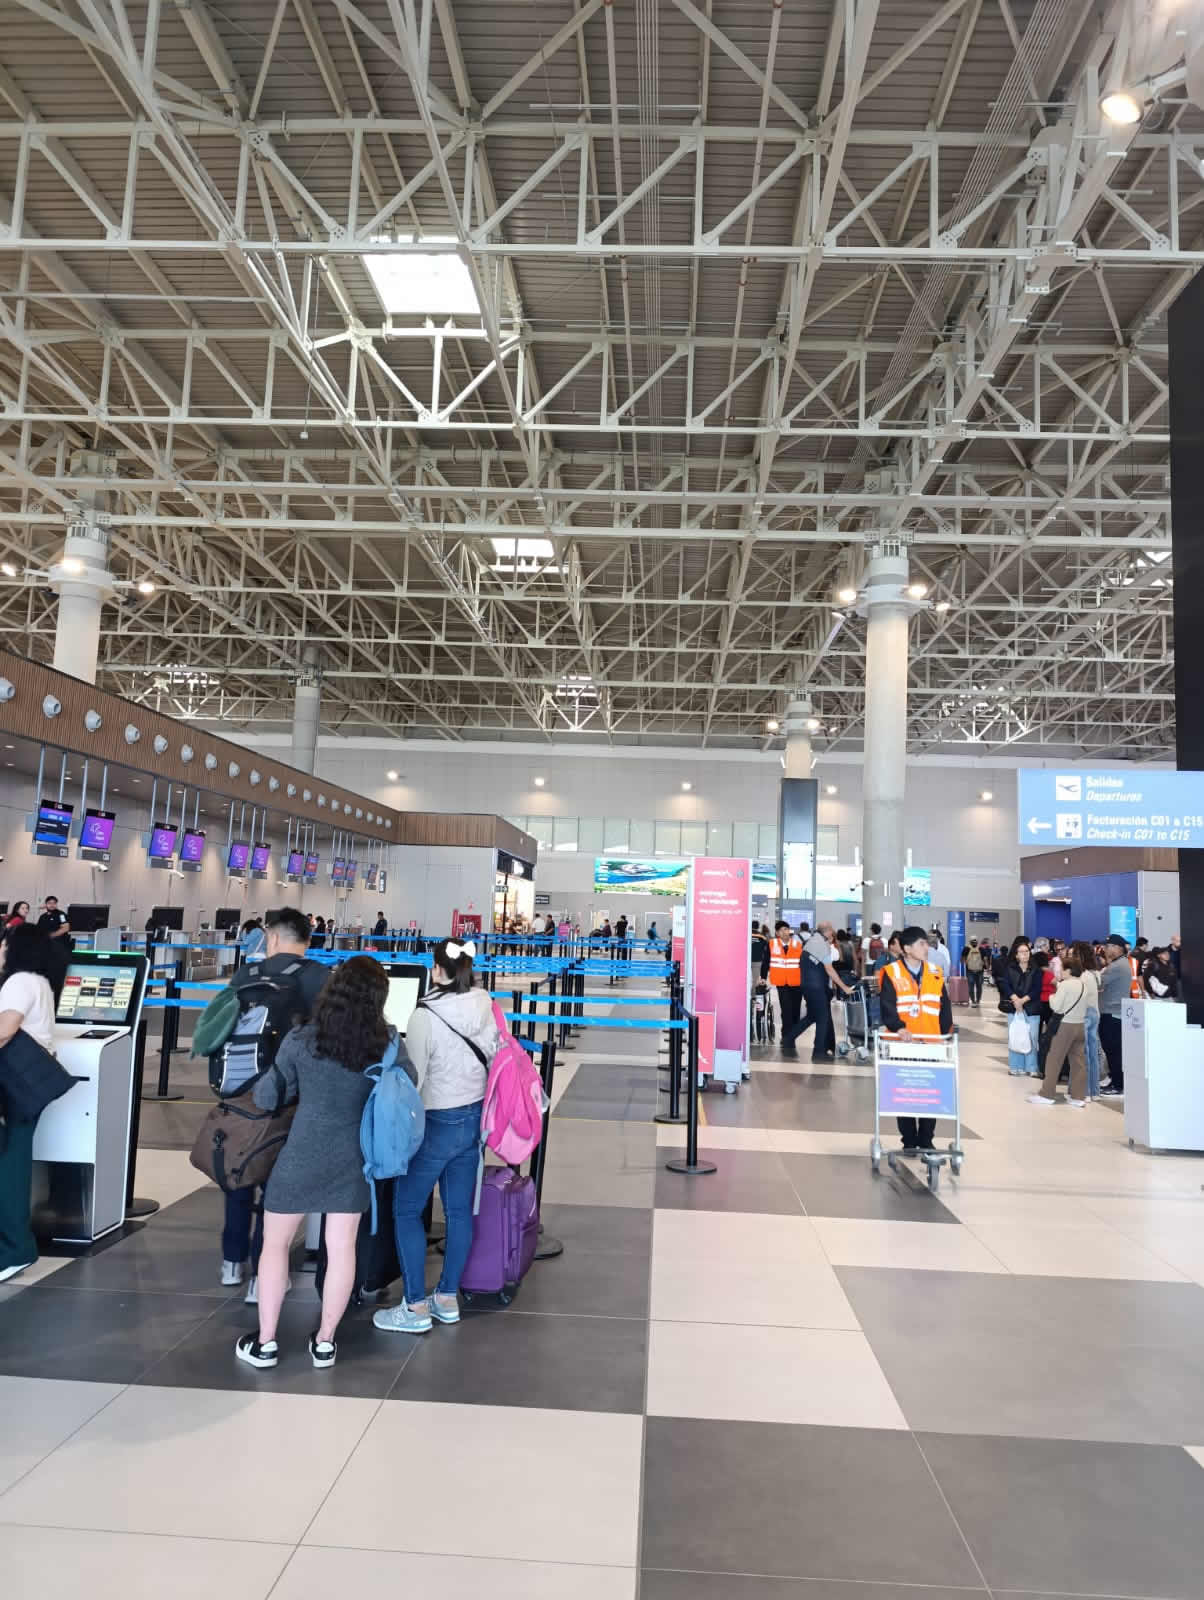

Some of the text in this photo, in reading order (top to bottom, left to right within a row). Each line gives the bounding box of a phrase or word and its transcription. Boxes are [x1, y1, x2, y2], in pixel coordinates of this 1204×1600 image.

[1086, 776, 1123, 788] Salidas
[1086, 791, 1143, 803] Departures
[1151, 815, 1170, 827] C01
[1183, 815, 1203, 827] C15
[1087, 827, 1191, 841] Check-in C01 to C15
